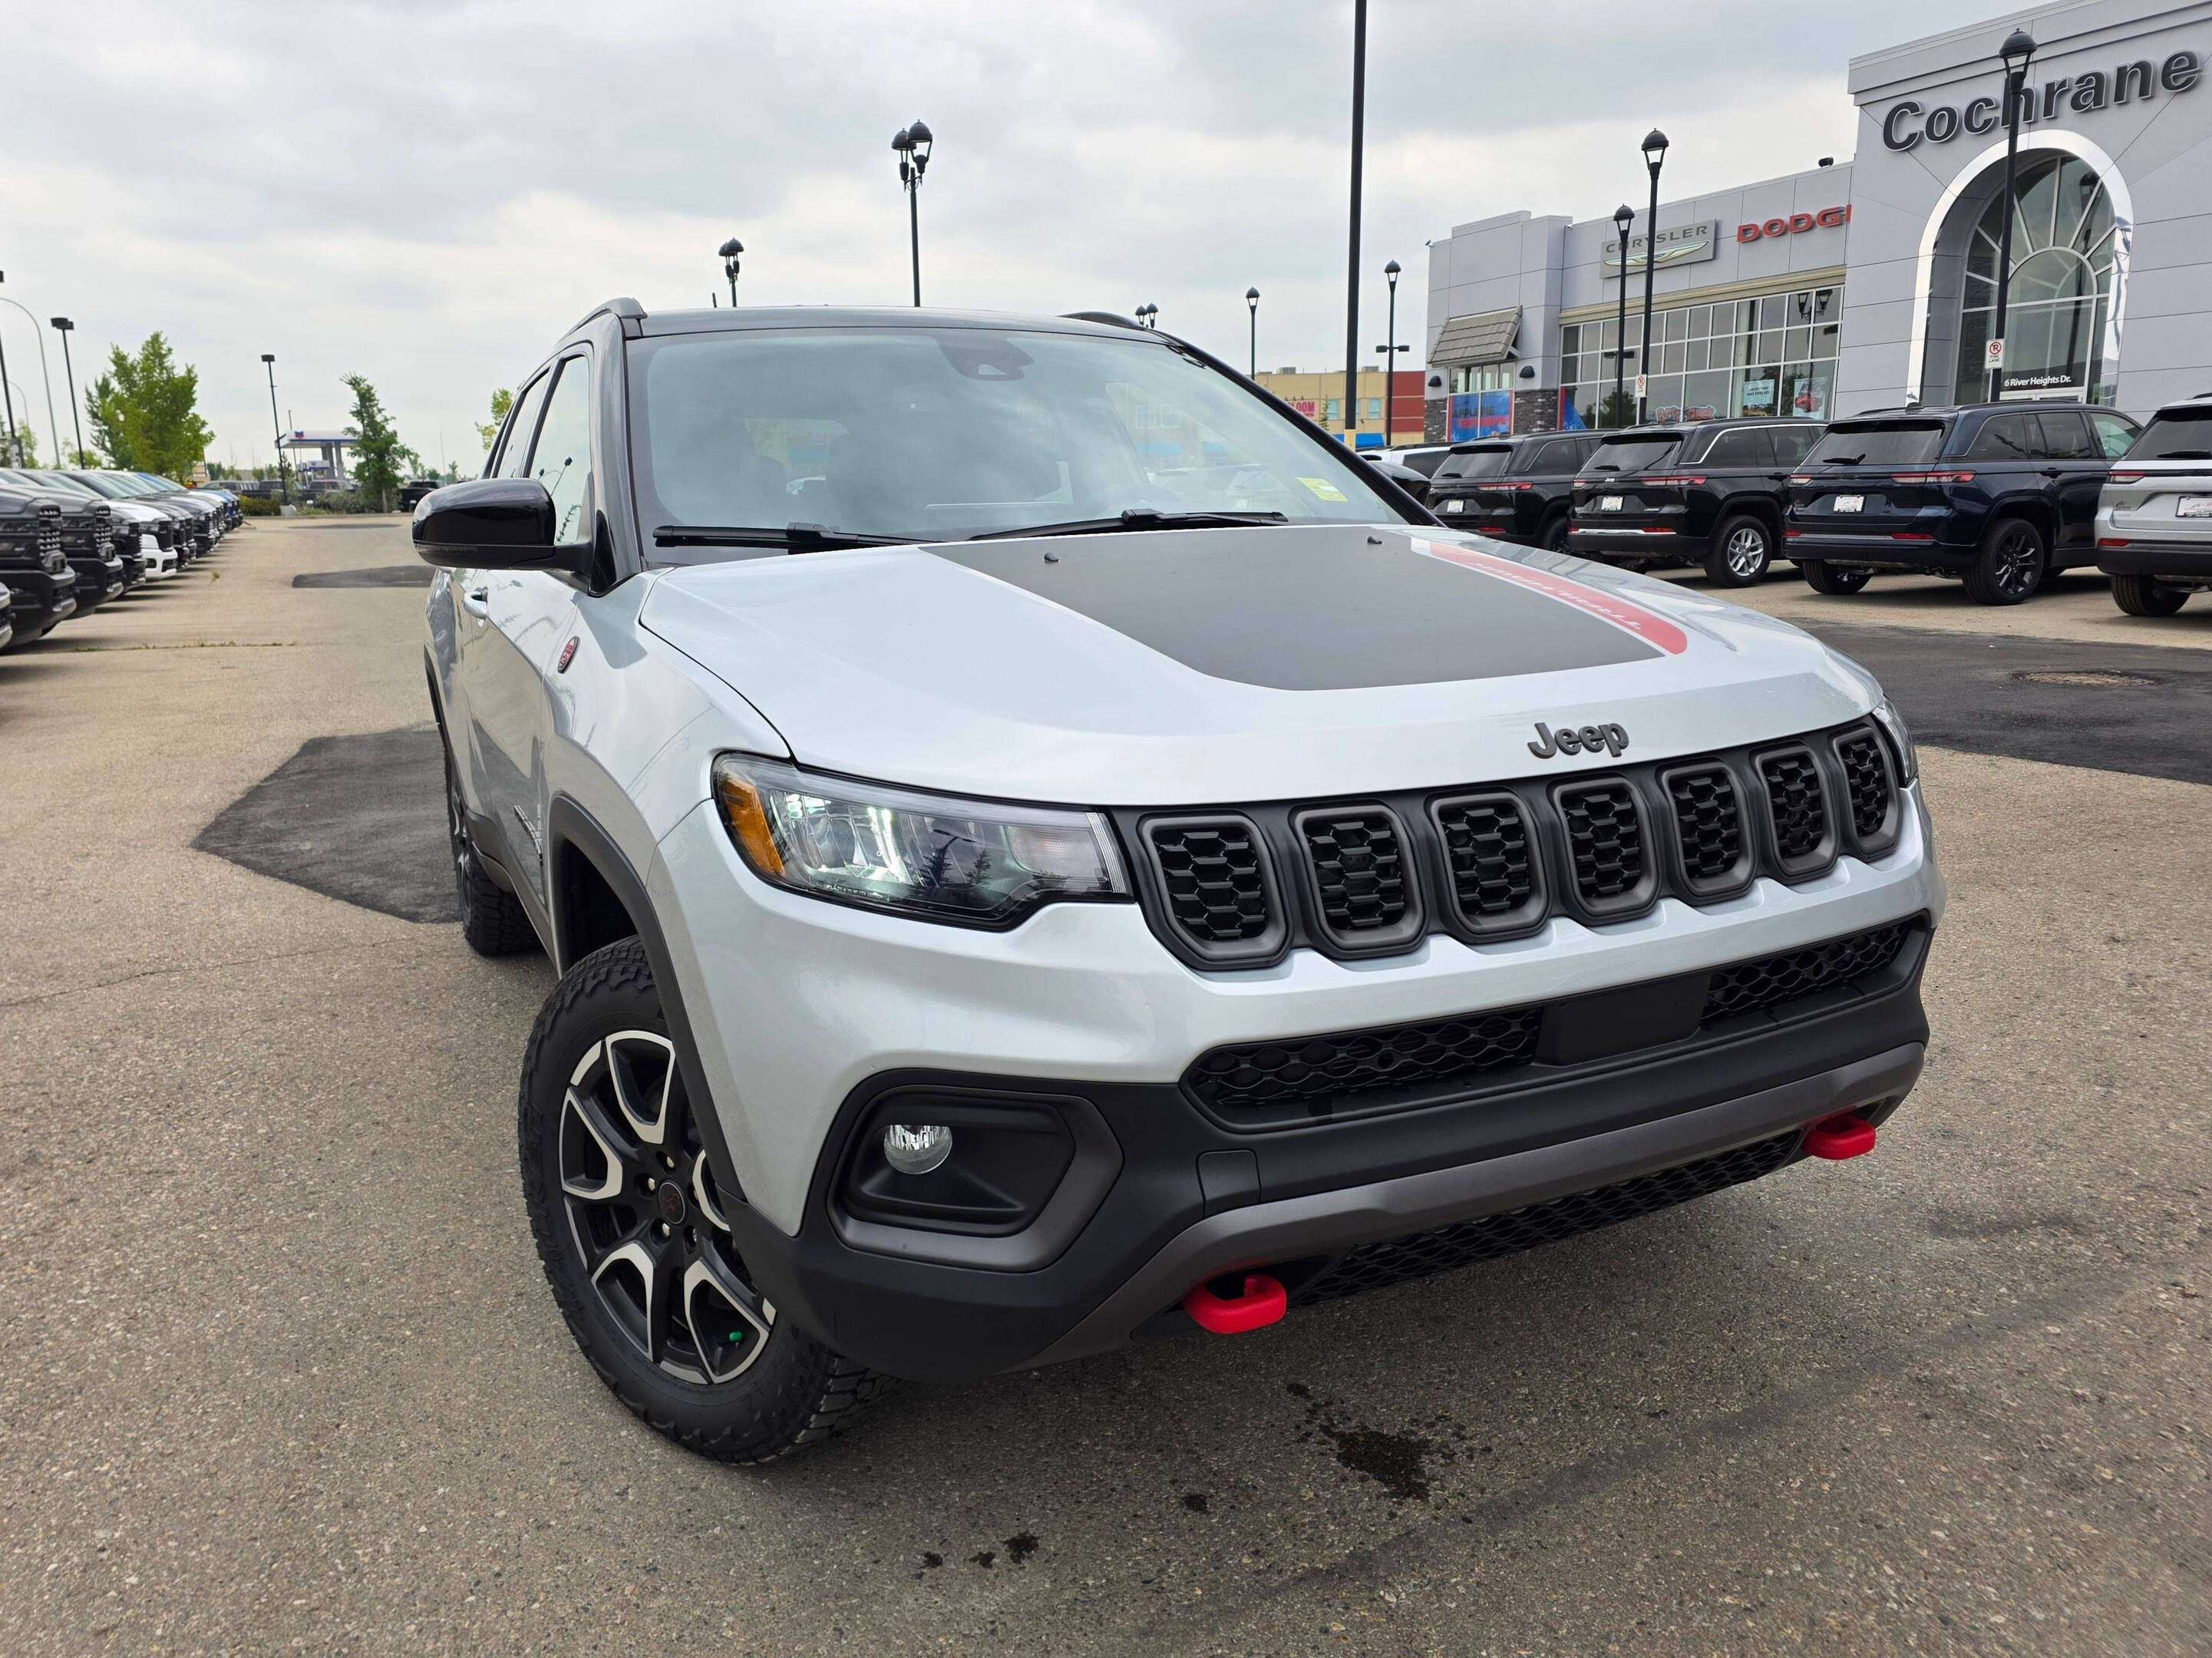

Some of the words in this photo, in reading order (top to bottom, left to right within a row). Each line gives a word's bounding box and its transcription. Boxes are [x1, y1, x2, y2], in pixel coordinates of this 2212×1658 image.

[1883, 49, 2200, 152] Cochrane
[1737, 204, 1852, 243] DODG
[2004, 378, 2010, 387] 6
[2010, 378, 2030, 386] River
[2030, 375, 2059, 386] Heights
[2060, 375, 2072, 383] Dr.
[1289, 401, 1315, 413] OOM
[1527, 722, 1629, 759] Jeep
